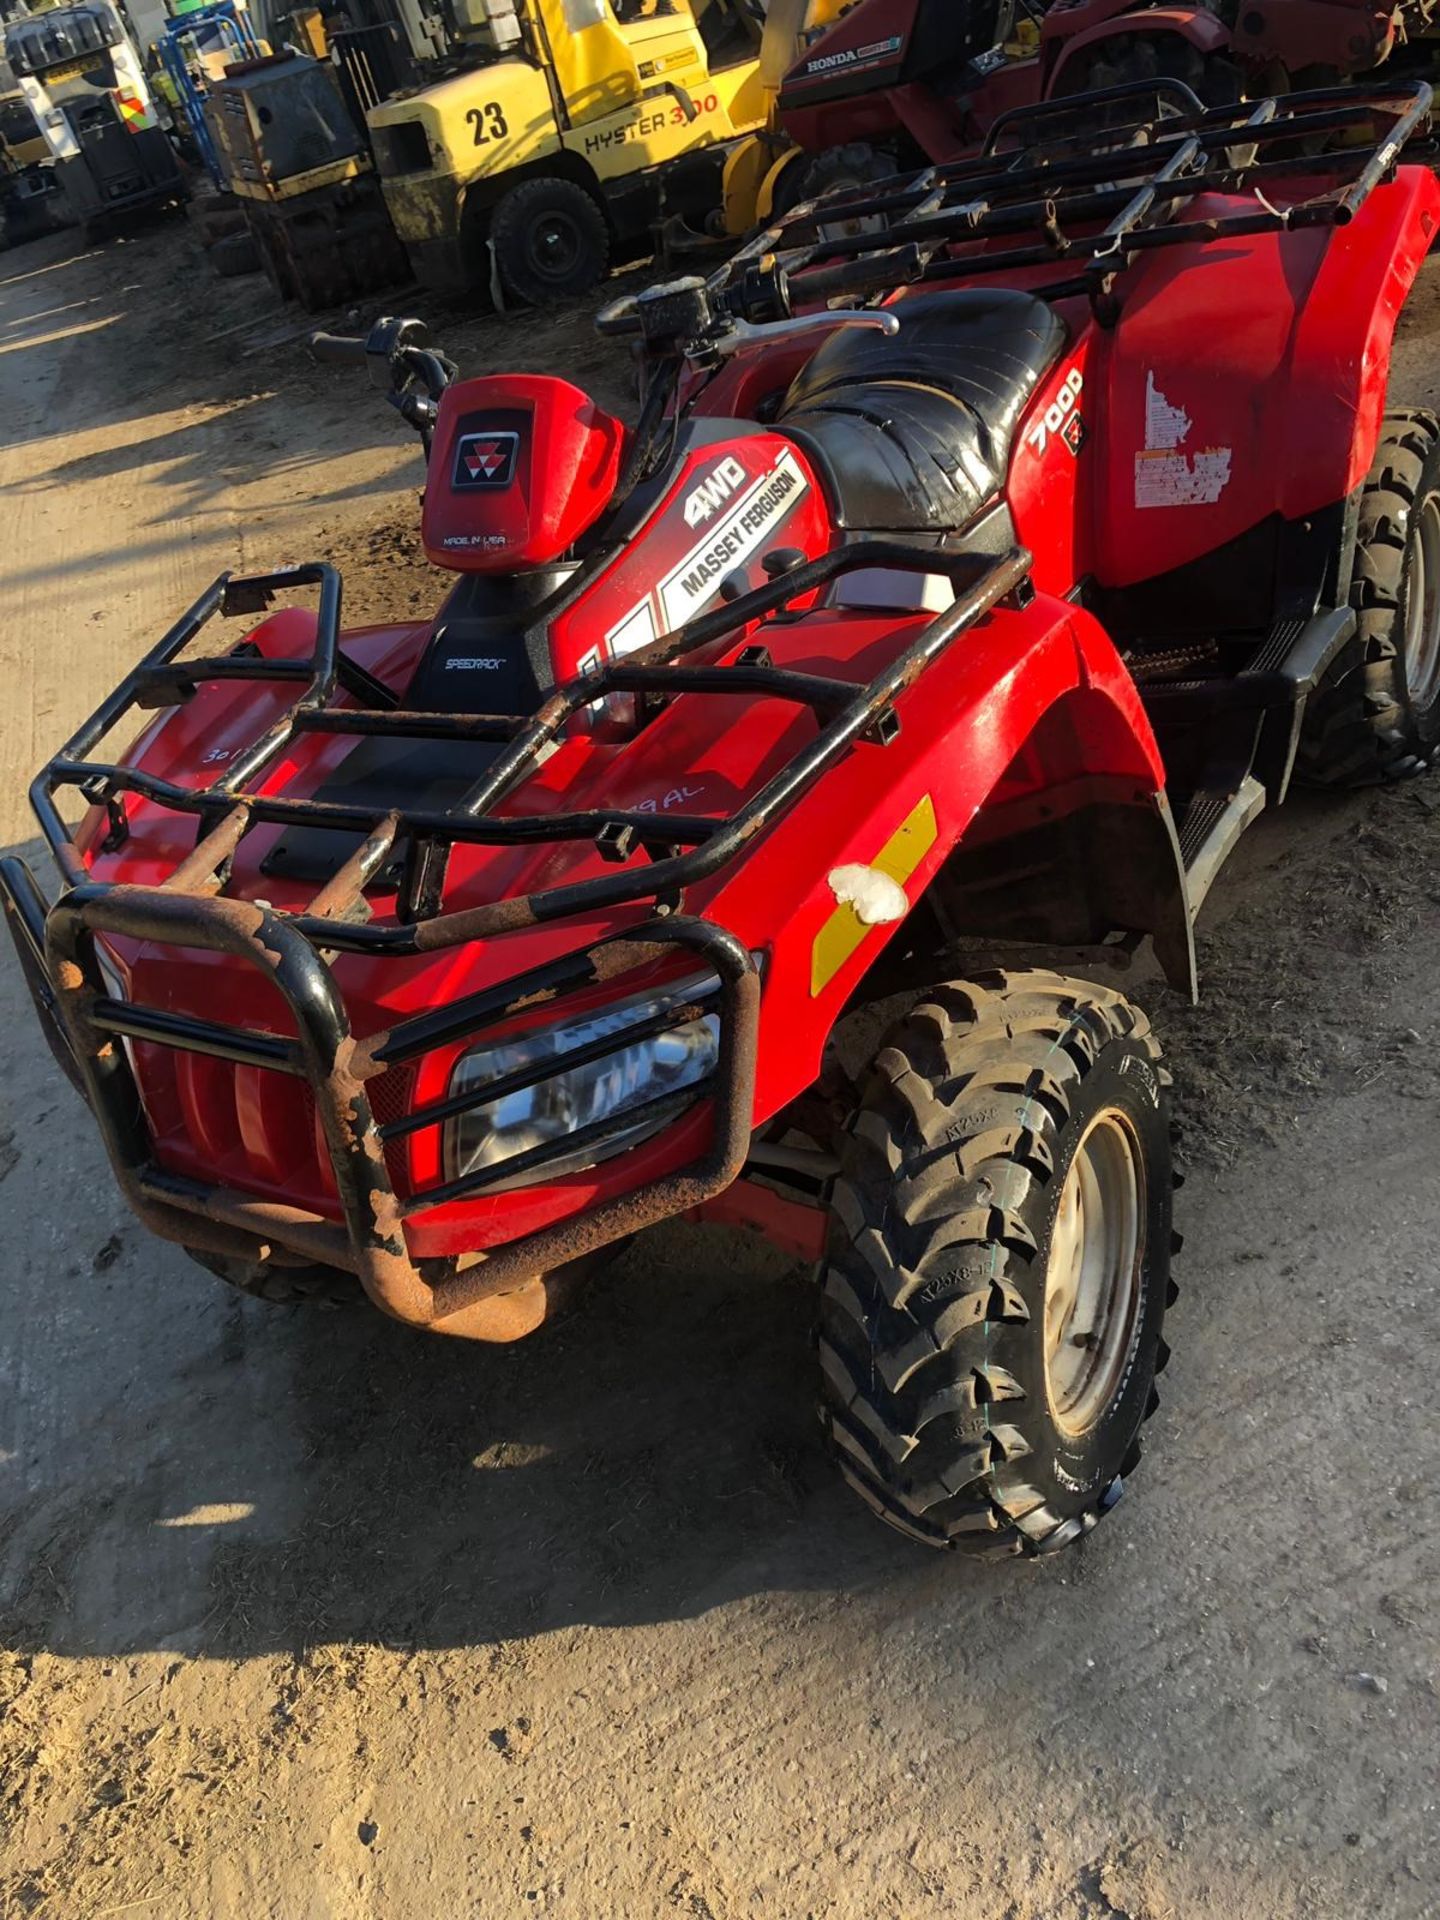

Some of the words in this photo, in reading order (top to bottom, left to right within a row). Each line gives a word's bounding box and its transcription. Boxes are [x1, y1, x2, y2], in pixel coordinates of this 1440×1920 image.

[807, 51, 858, 72] HONDA
[466, 101, 508, 146] 23
[585, 112, 665, 154] HYSTER
[1028, 367, 1083, 456] 7000
[684, 456, 746, 529] 4WD
[471, 535, 480, 545] IN
[680, 526, 746, 597] MASSEY
[740, 469, 798, 536] FERGUSON
